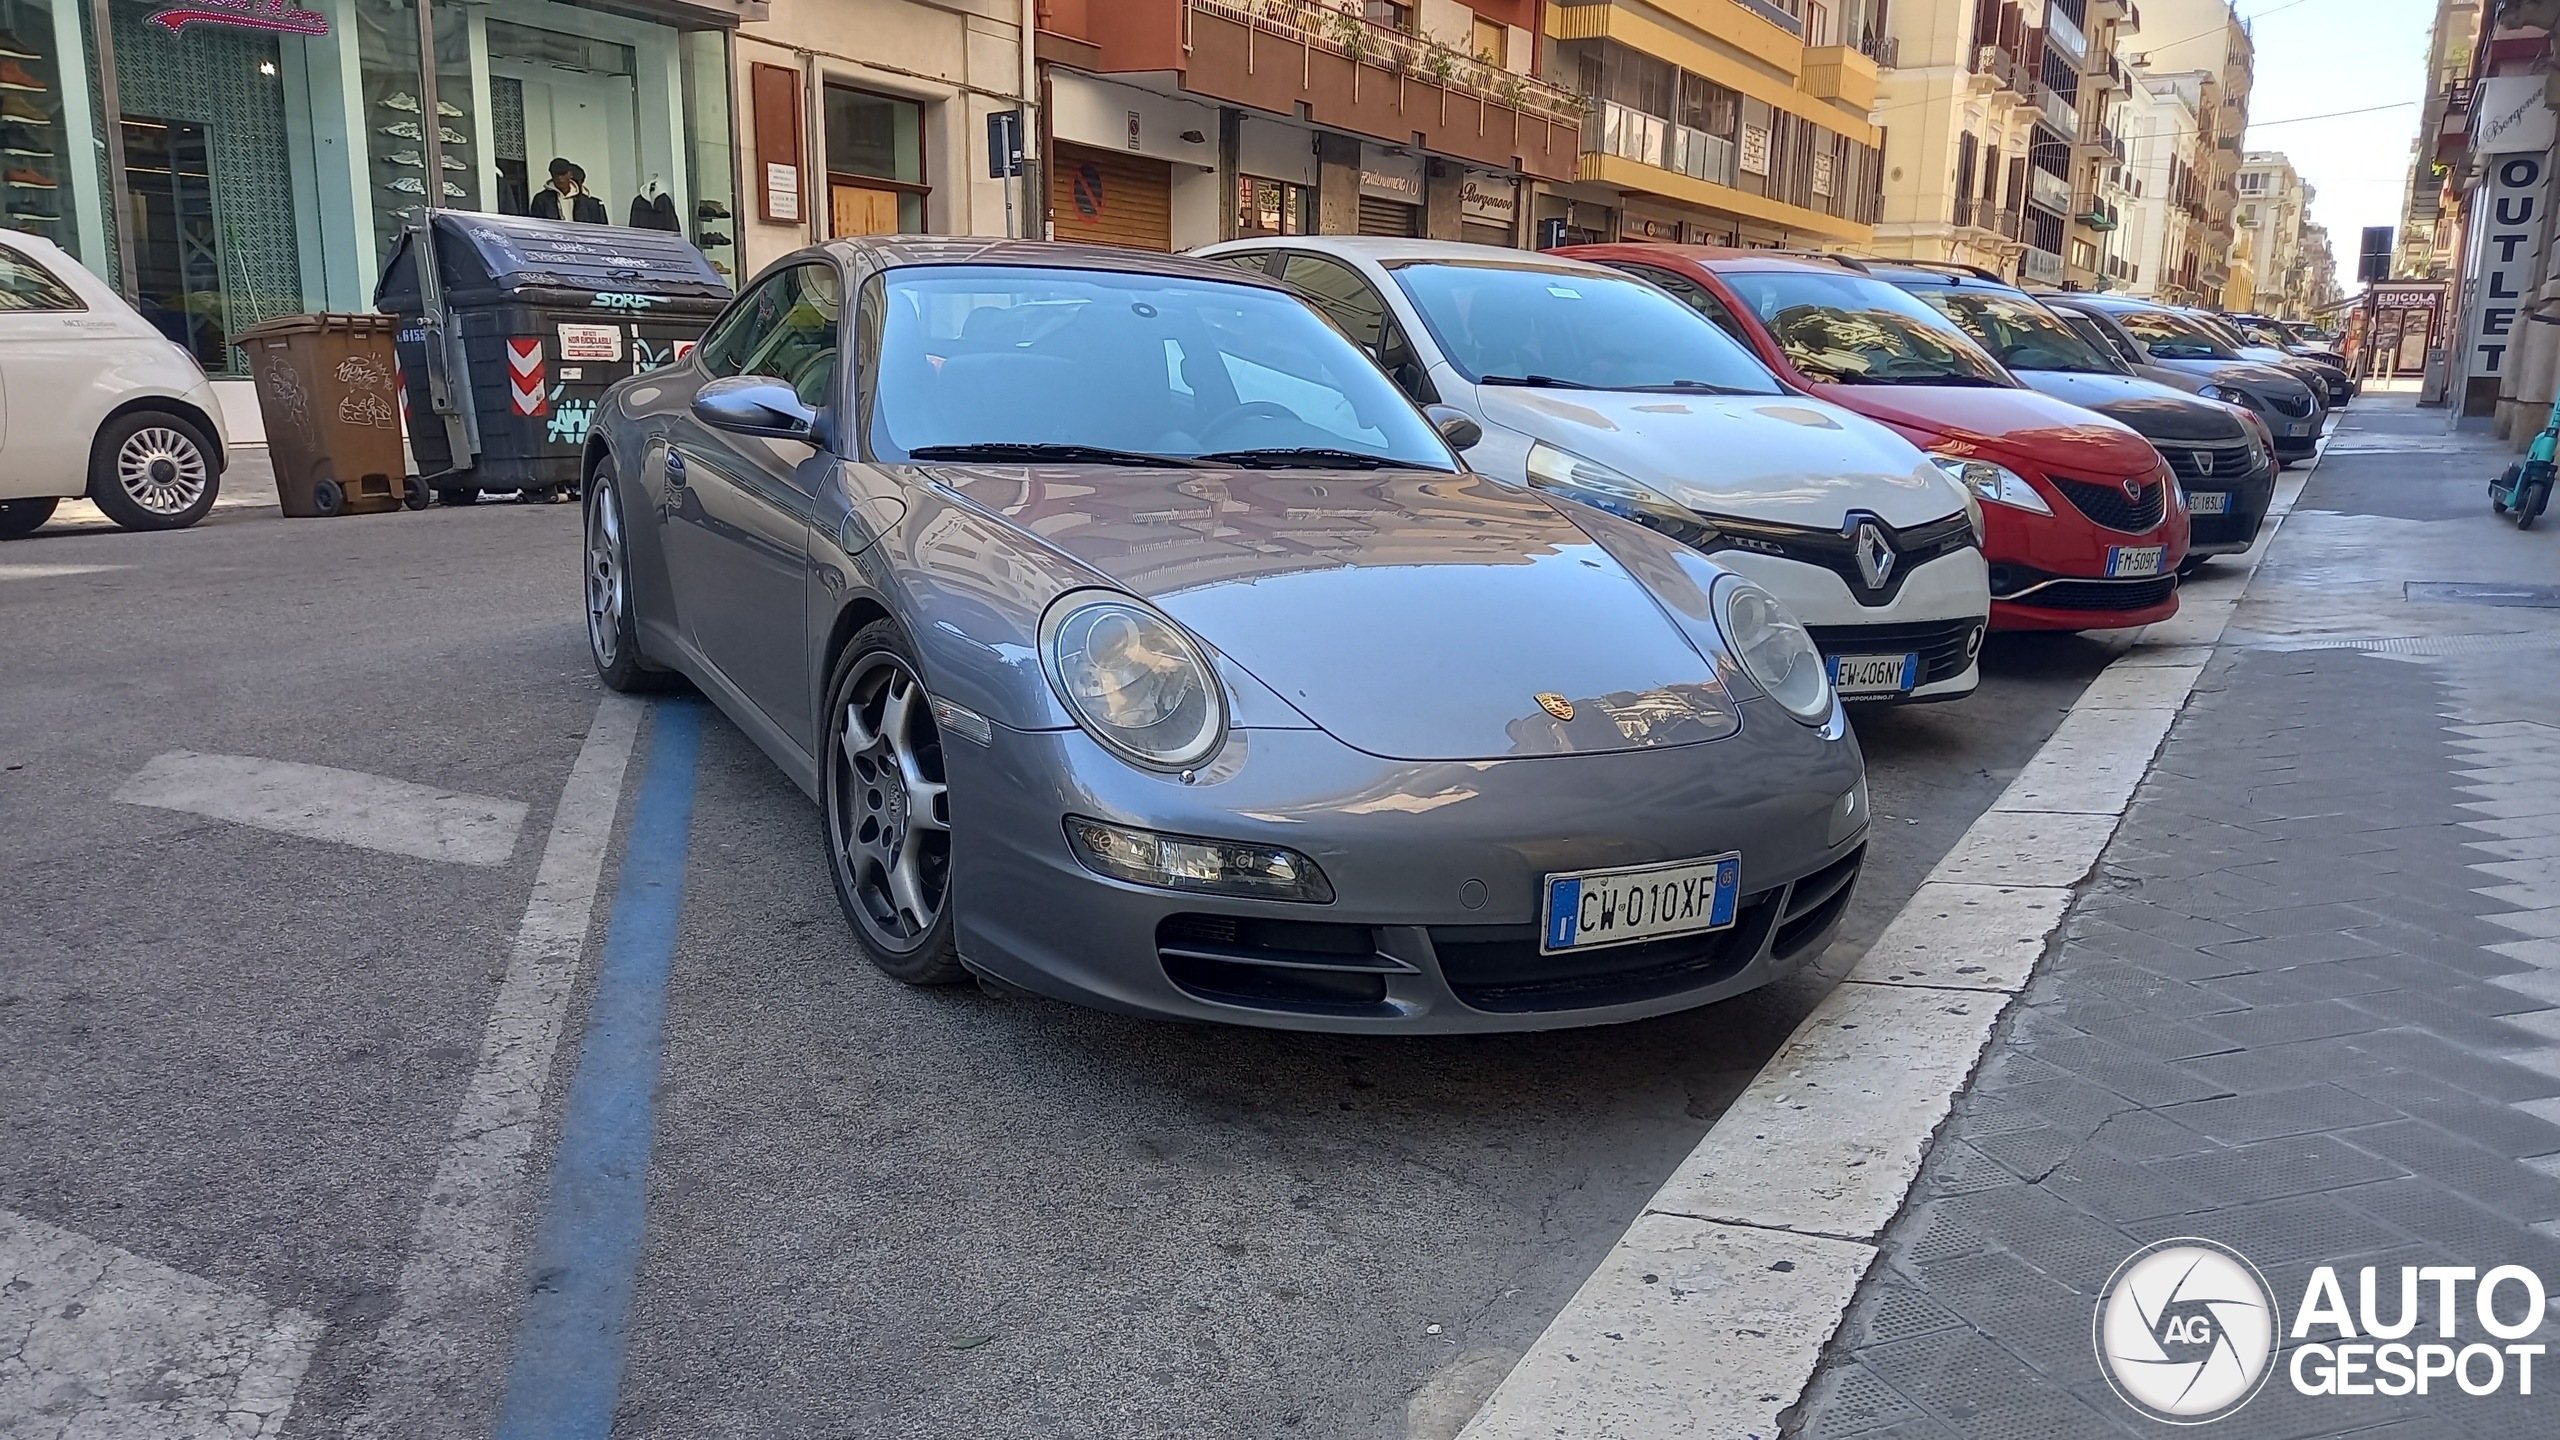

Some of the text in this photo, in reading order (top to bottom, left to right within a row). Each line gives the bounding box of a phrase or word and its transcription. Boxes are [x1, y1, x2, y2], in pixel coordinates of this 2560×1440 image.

[1461, 182, 1513, 211] Borgonovo
[2477, 159, 2539, 372] OUTLET
[2377, 292, 2436, 302] EDICOLA
